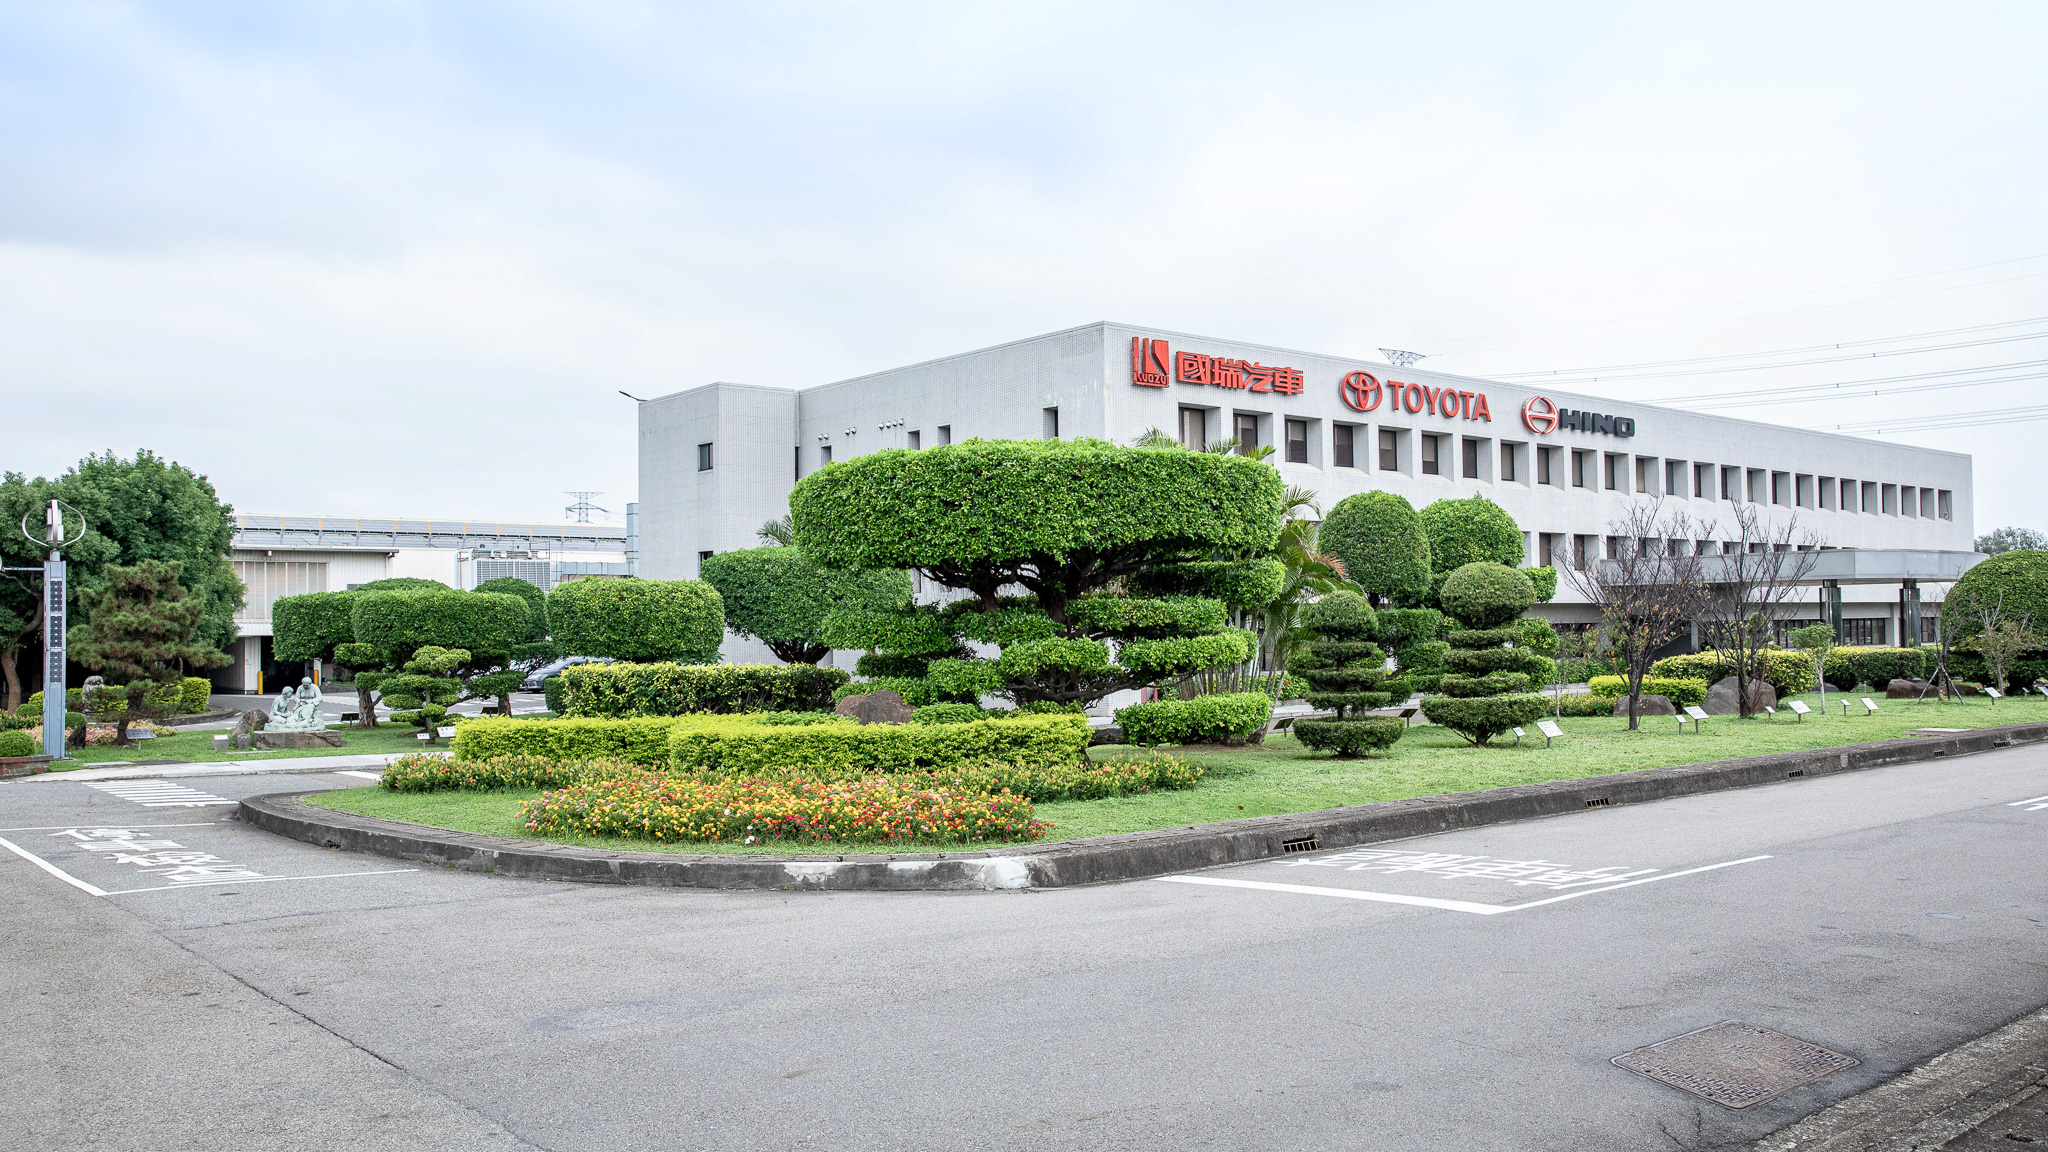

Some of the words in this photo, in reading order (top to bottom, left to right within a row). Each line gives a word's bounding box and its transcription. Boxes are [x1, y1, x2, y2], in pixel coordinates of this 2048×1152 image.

[1176, 351, 1304, 395] 國瑞汽車
[1388, 380, 1492, 423] TOYOTA
[1559, 408, 1635, 438] HINO
[1272, 848, 1661, 890] 停車檢查
